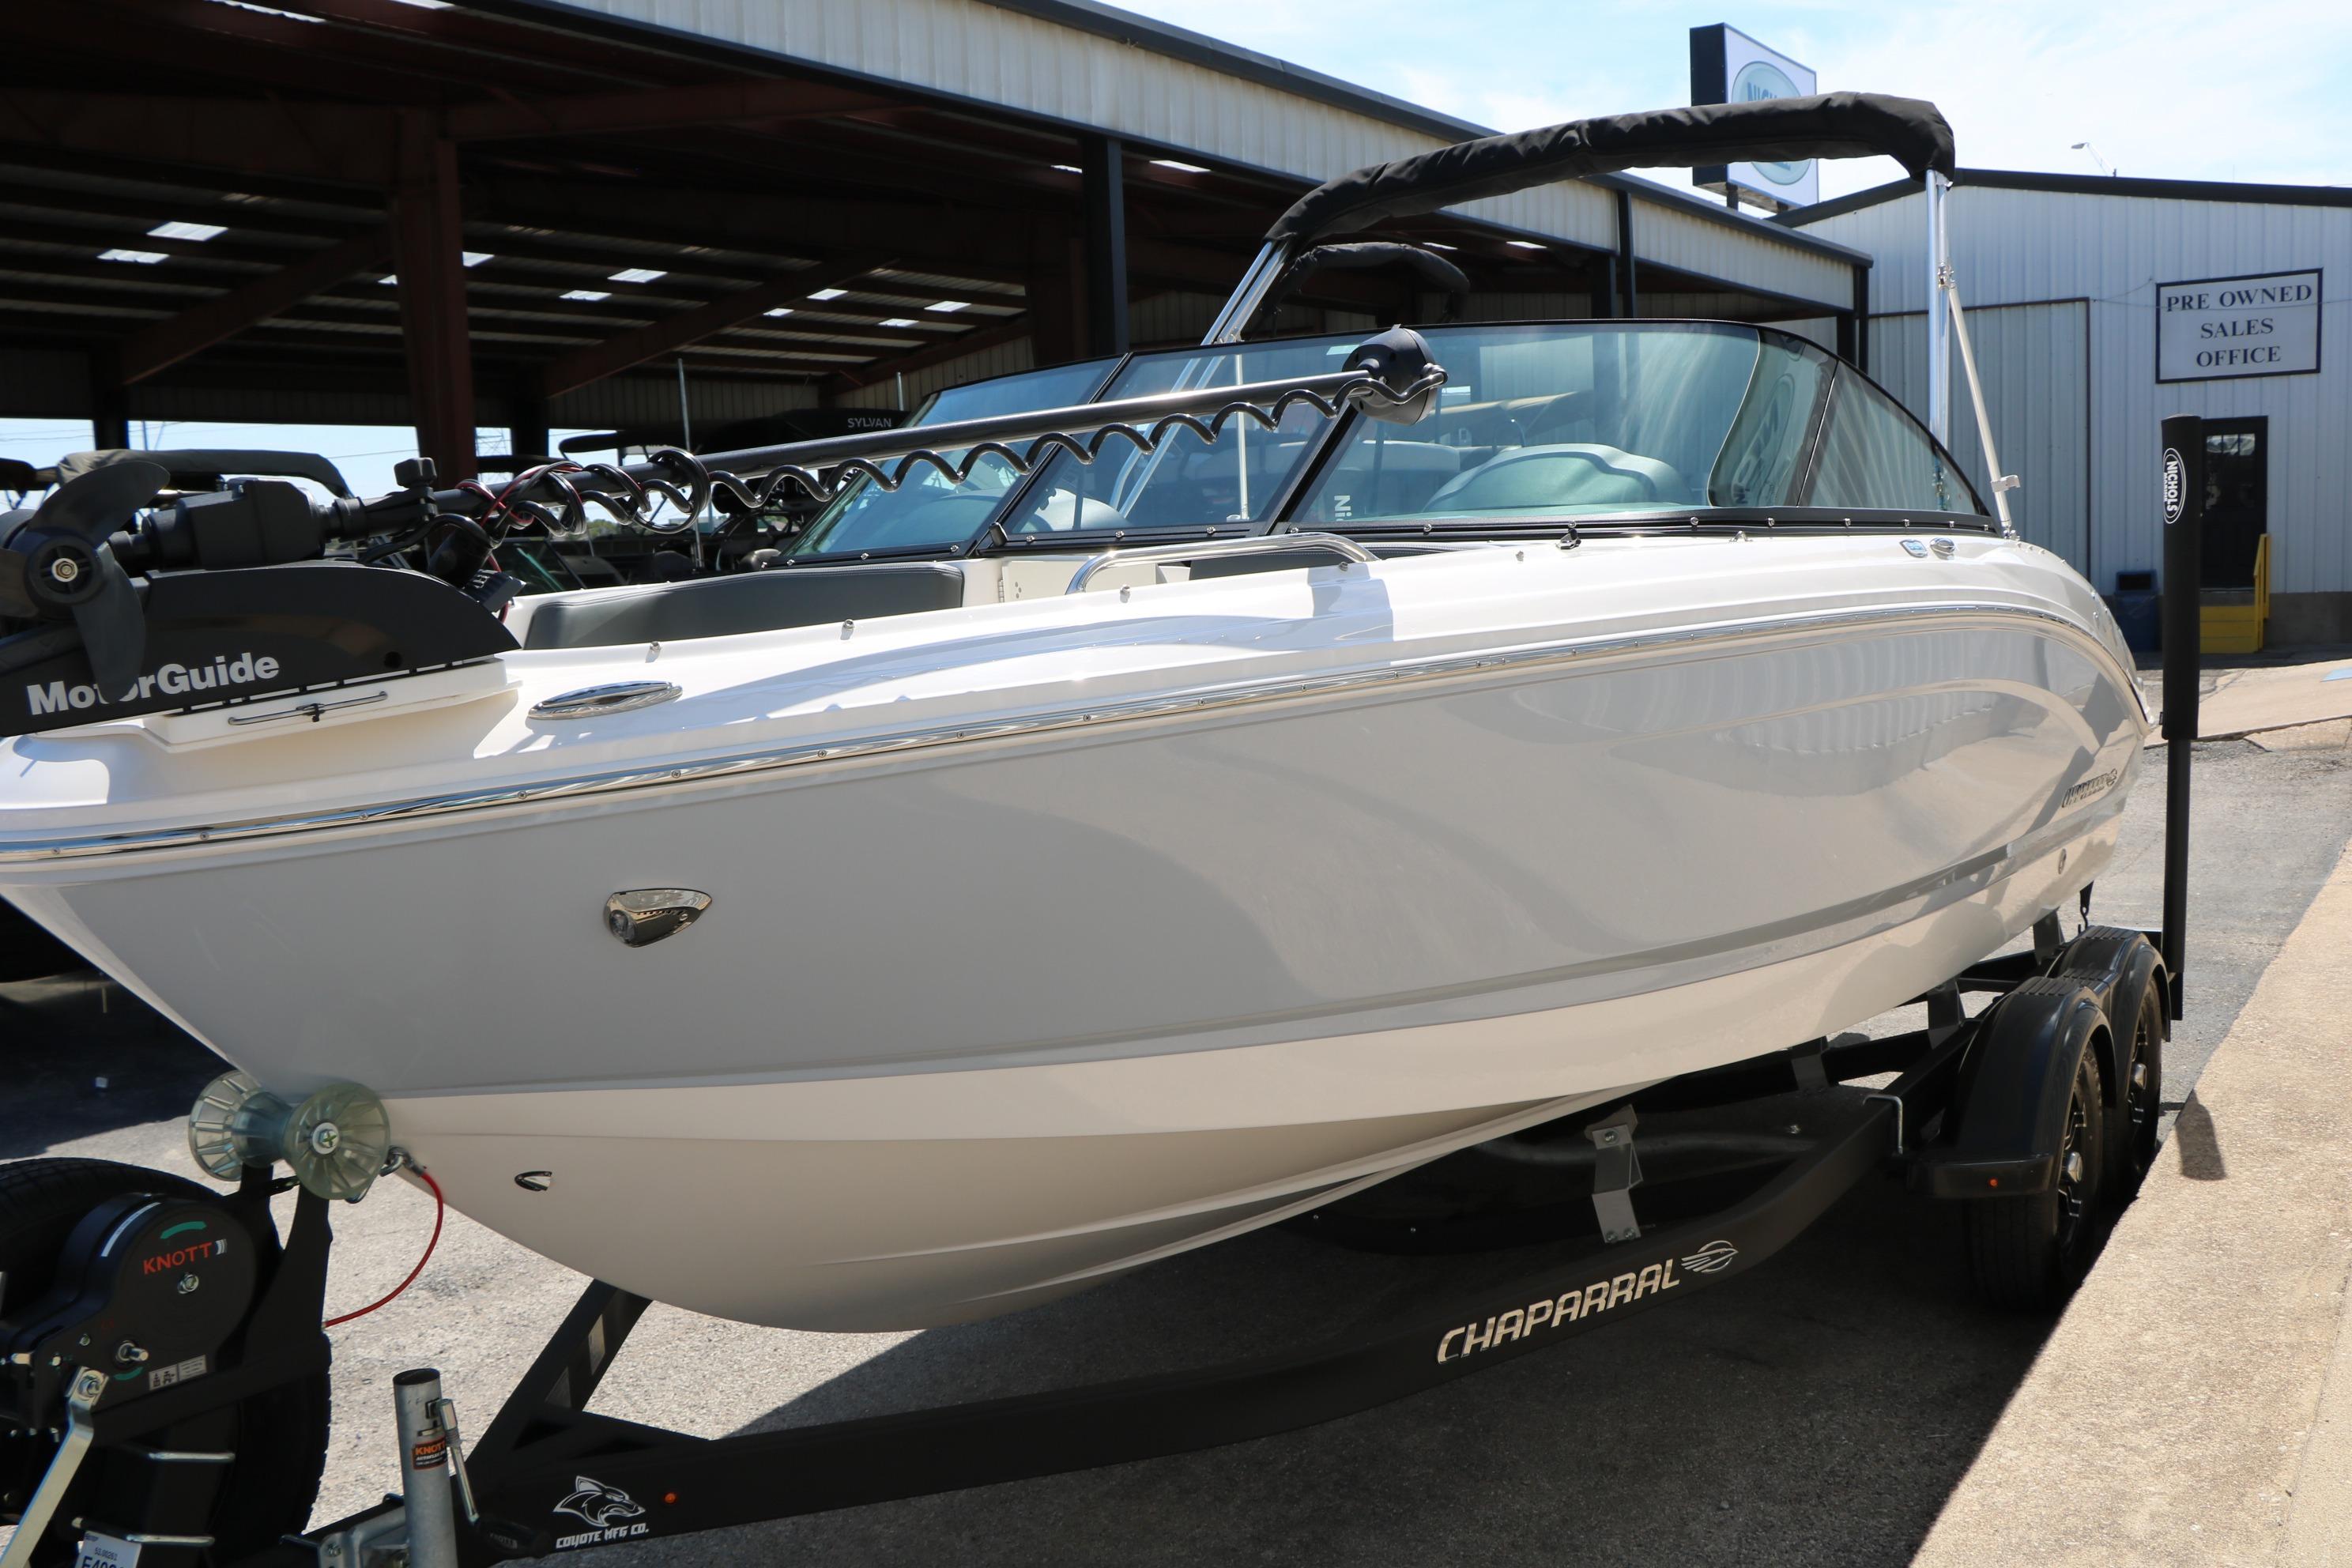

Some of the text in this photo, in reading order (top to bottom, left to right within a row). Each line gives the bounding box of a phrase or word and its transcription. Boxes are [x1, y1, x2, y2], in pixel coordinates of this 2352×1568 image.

[2166, 285, 2312, 312] PRE OWNED
[2200, 318, 2274, 339] SALES
[2196, 346, 2281, 368] OFFICE
[847, 417, 891, 428] SYLVAN
[2166, 460, 2178, 511] NICHOLS
[1334, 495, 1352, 522] Ni
[27, 653, 279, 715] MorGuide
[143, 1242, 213, 1275] KNOTT
[1436, 1258, 1680, 1365] CHAPARRAL
[556, 1522, 650, 1549] COYOTE MFG CO.
